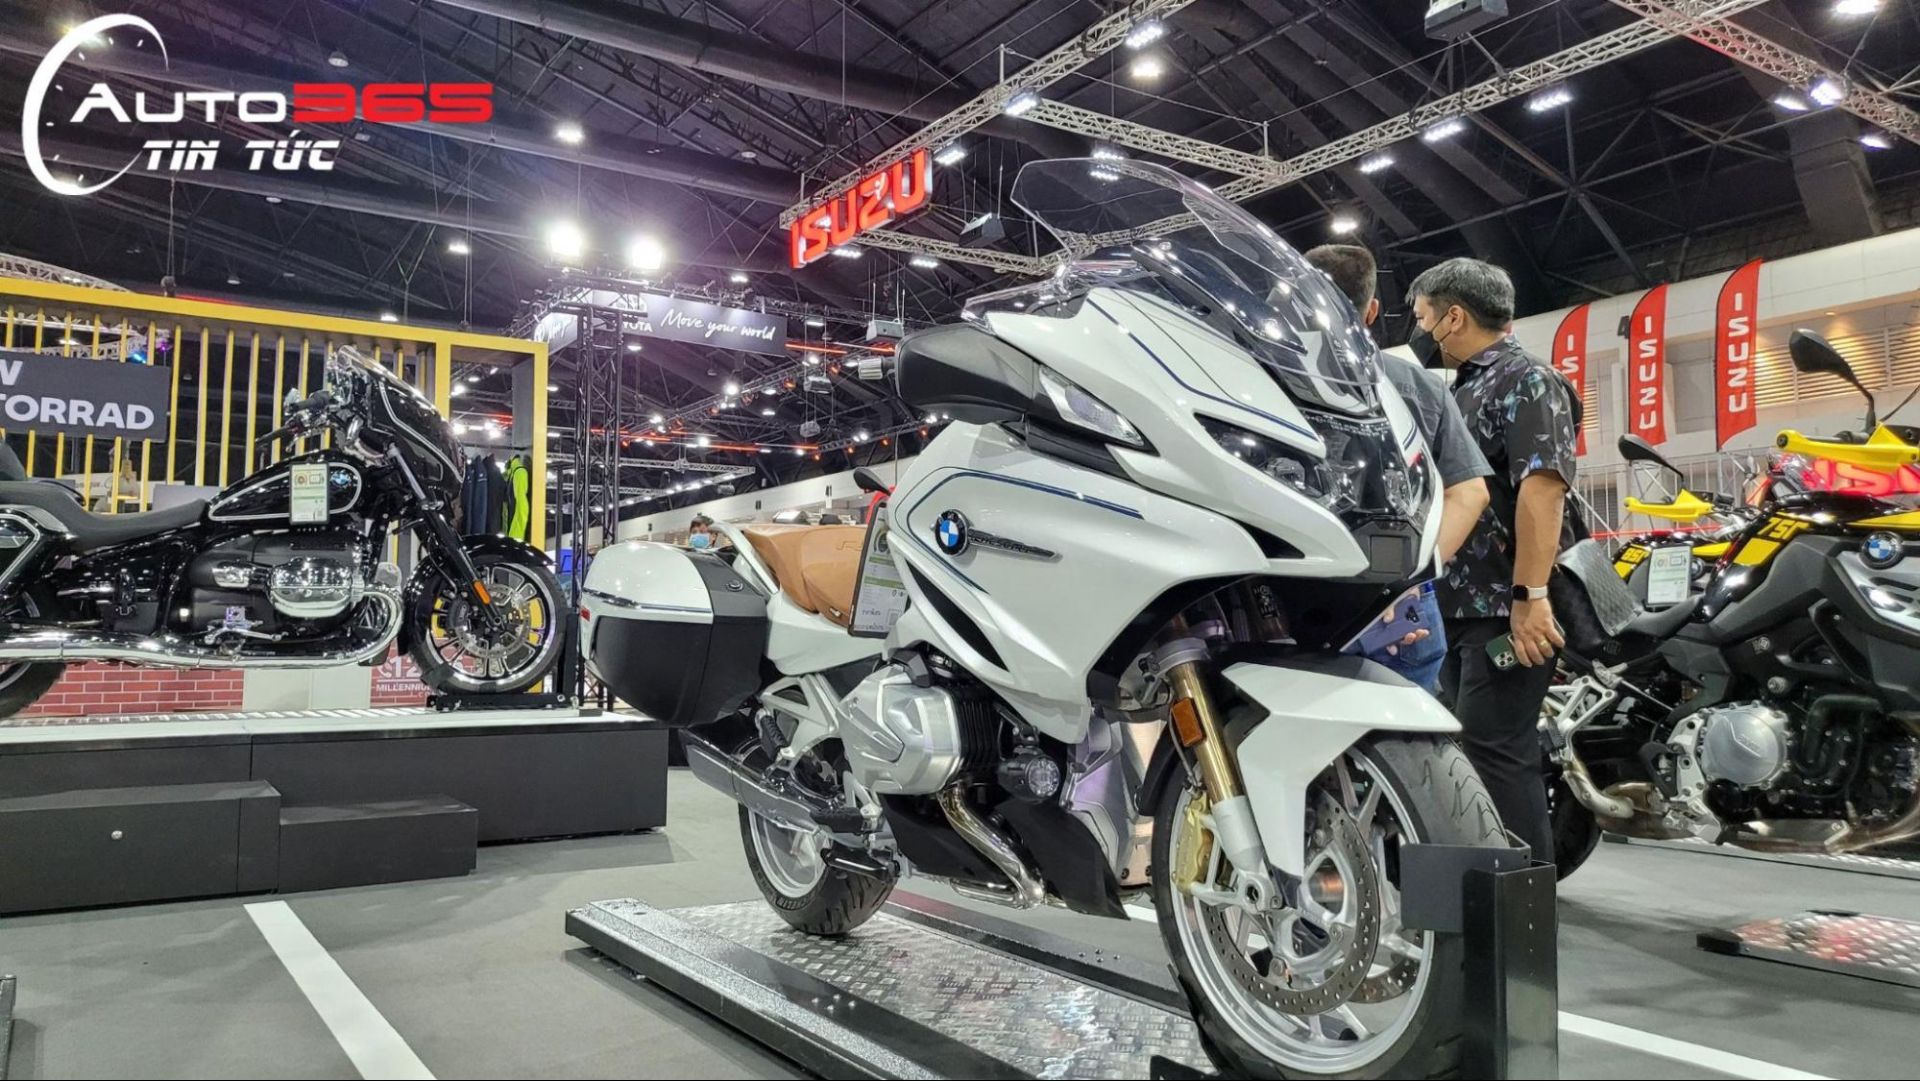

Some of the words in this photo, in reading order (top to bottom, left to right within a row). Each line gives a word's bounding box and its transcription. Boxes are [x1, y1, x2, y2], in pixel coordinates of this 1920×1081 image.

[790, 149, 930, 269] ISUZU
[660, 309, 704, 329] Move
[706, 320, 737, 339] your
[740, 325, 776, 341] world
[1638, 316, 1658, 430] ISUZU
[1728, 292, 1750, 413] ISUZU
[0, 394, 154, 430] ORRAD
